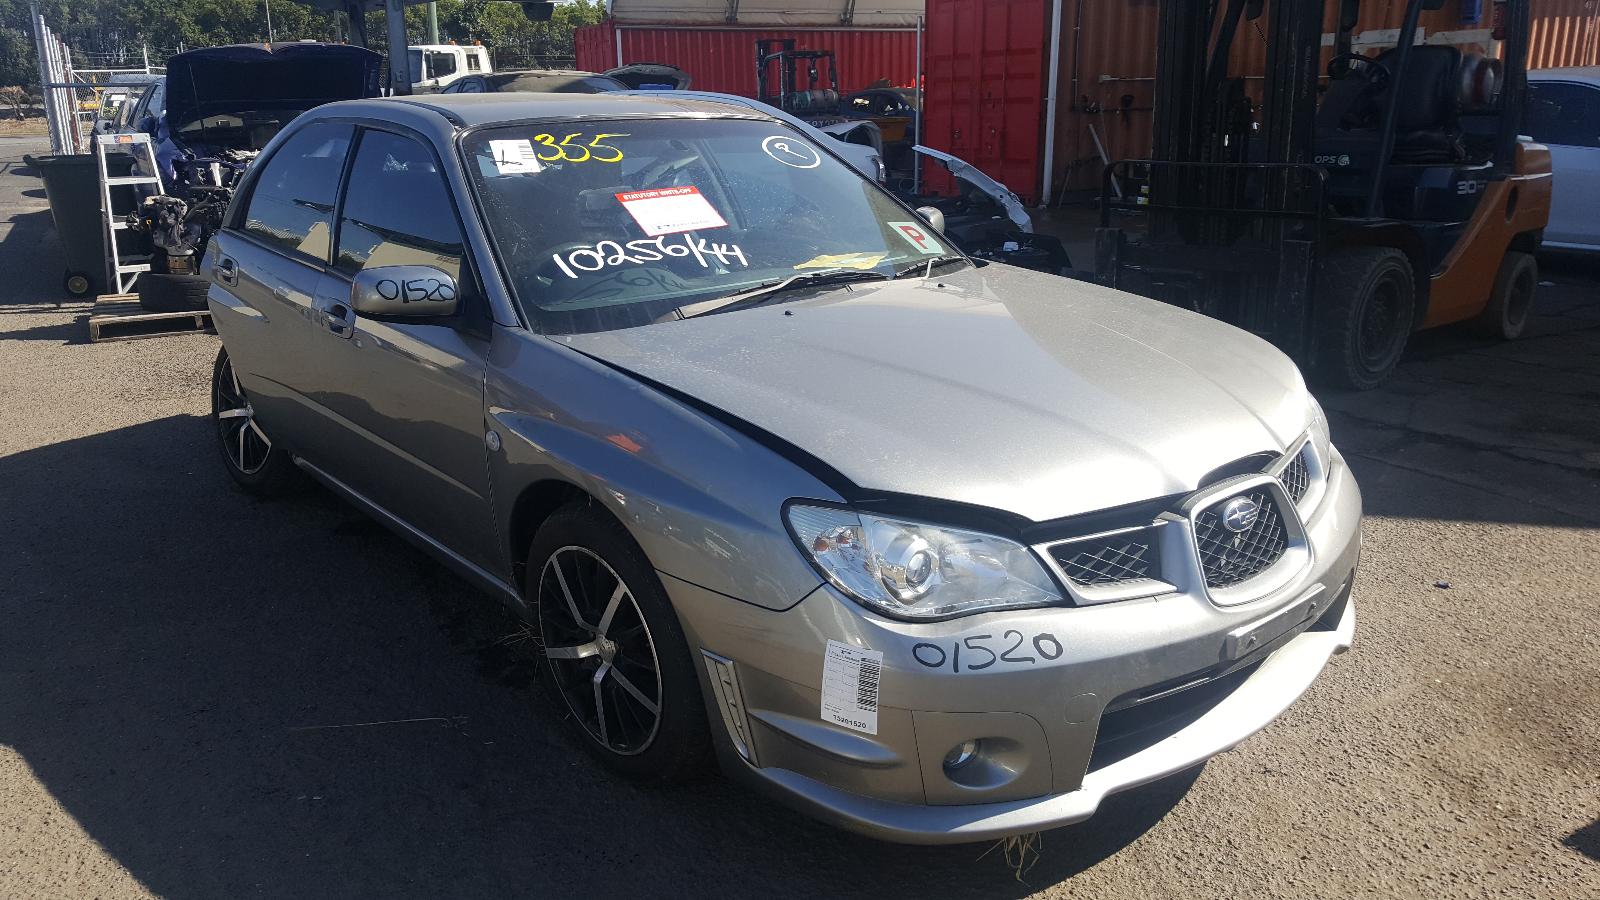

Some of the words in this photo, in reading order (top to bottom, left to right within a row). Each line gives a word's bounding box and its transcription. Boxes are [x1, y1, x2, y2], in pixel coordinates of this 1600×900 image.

[533, 132, 631, 163] 355
[1314, 155, 1337, 164] OPS
[622, 192, 658, 200] STATUTORY
[1457, 180, 1477, 195] 30
[898, 225, 928, 250] P
[375, 278, 457, 304] 01520
[912, 629, 1064, 673] 01520
